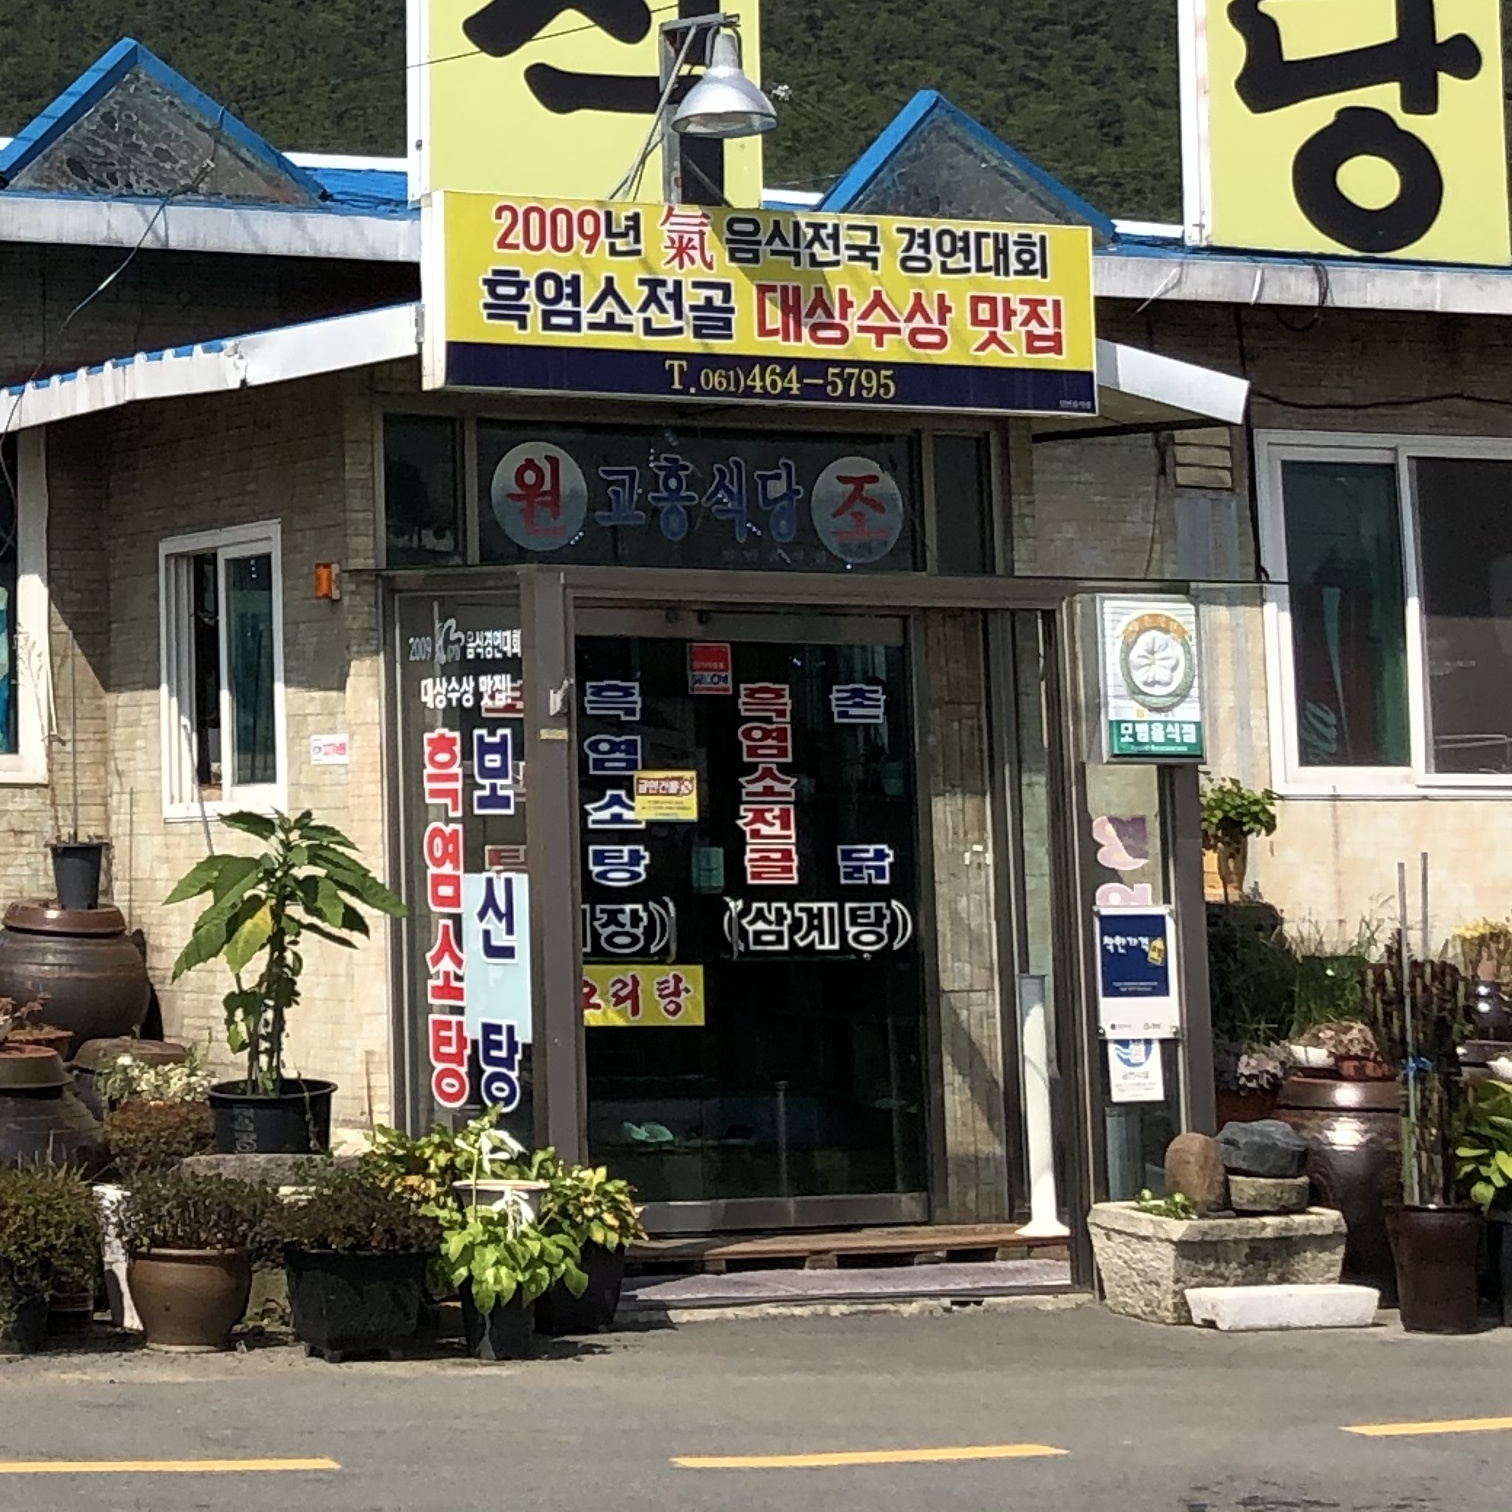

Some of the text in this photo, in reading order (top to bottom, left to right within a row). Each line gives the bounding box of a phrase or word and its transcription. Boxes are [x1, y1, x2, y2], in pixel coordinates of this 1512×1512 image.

[494, 204, 1049, 280] 2009년 氣 음식전국 경연대회
[481, 268, 1065, 357] 흑염소전골 대상수상 맛집
[506, 454, 567, 538] 원
[594, 453, 804, 543] 고흥식당
[831, 473, 887, 540] 조
[420, 675, 475, 709] 대상수상
[1120, 722, 1197, 743] 모범음식점
[736, 683, 799, 885] 흑염소전골
